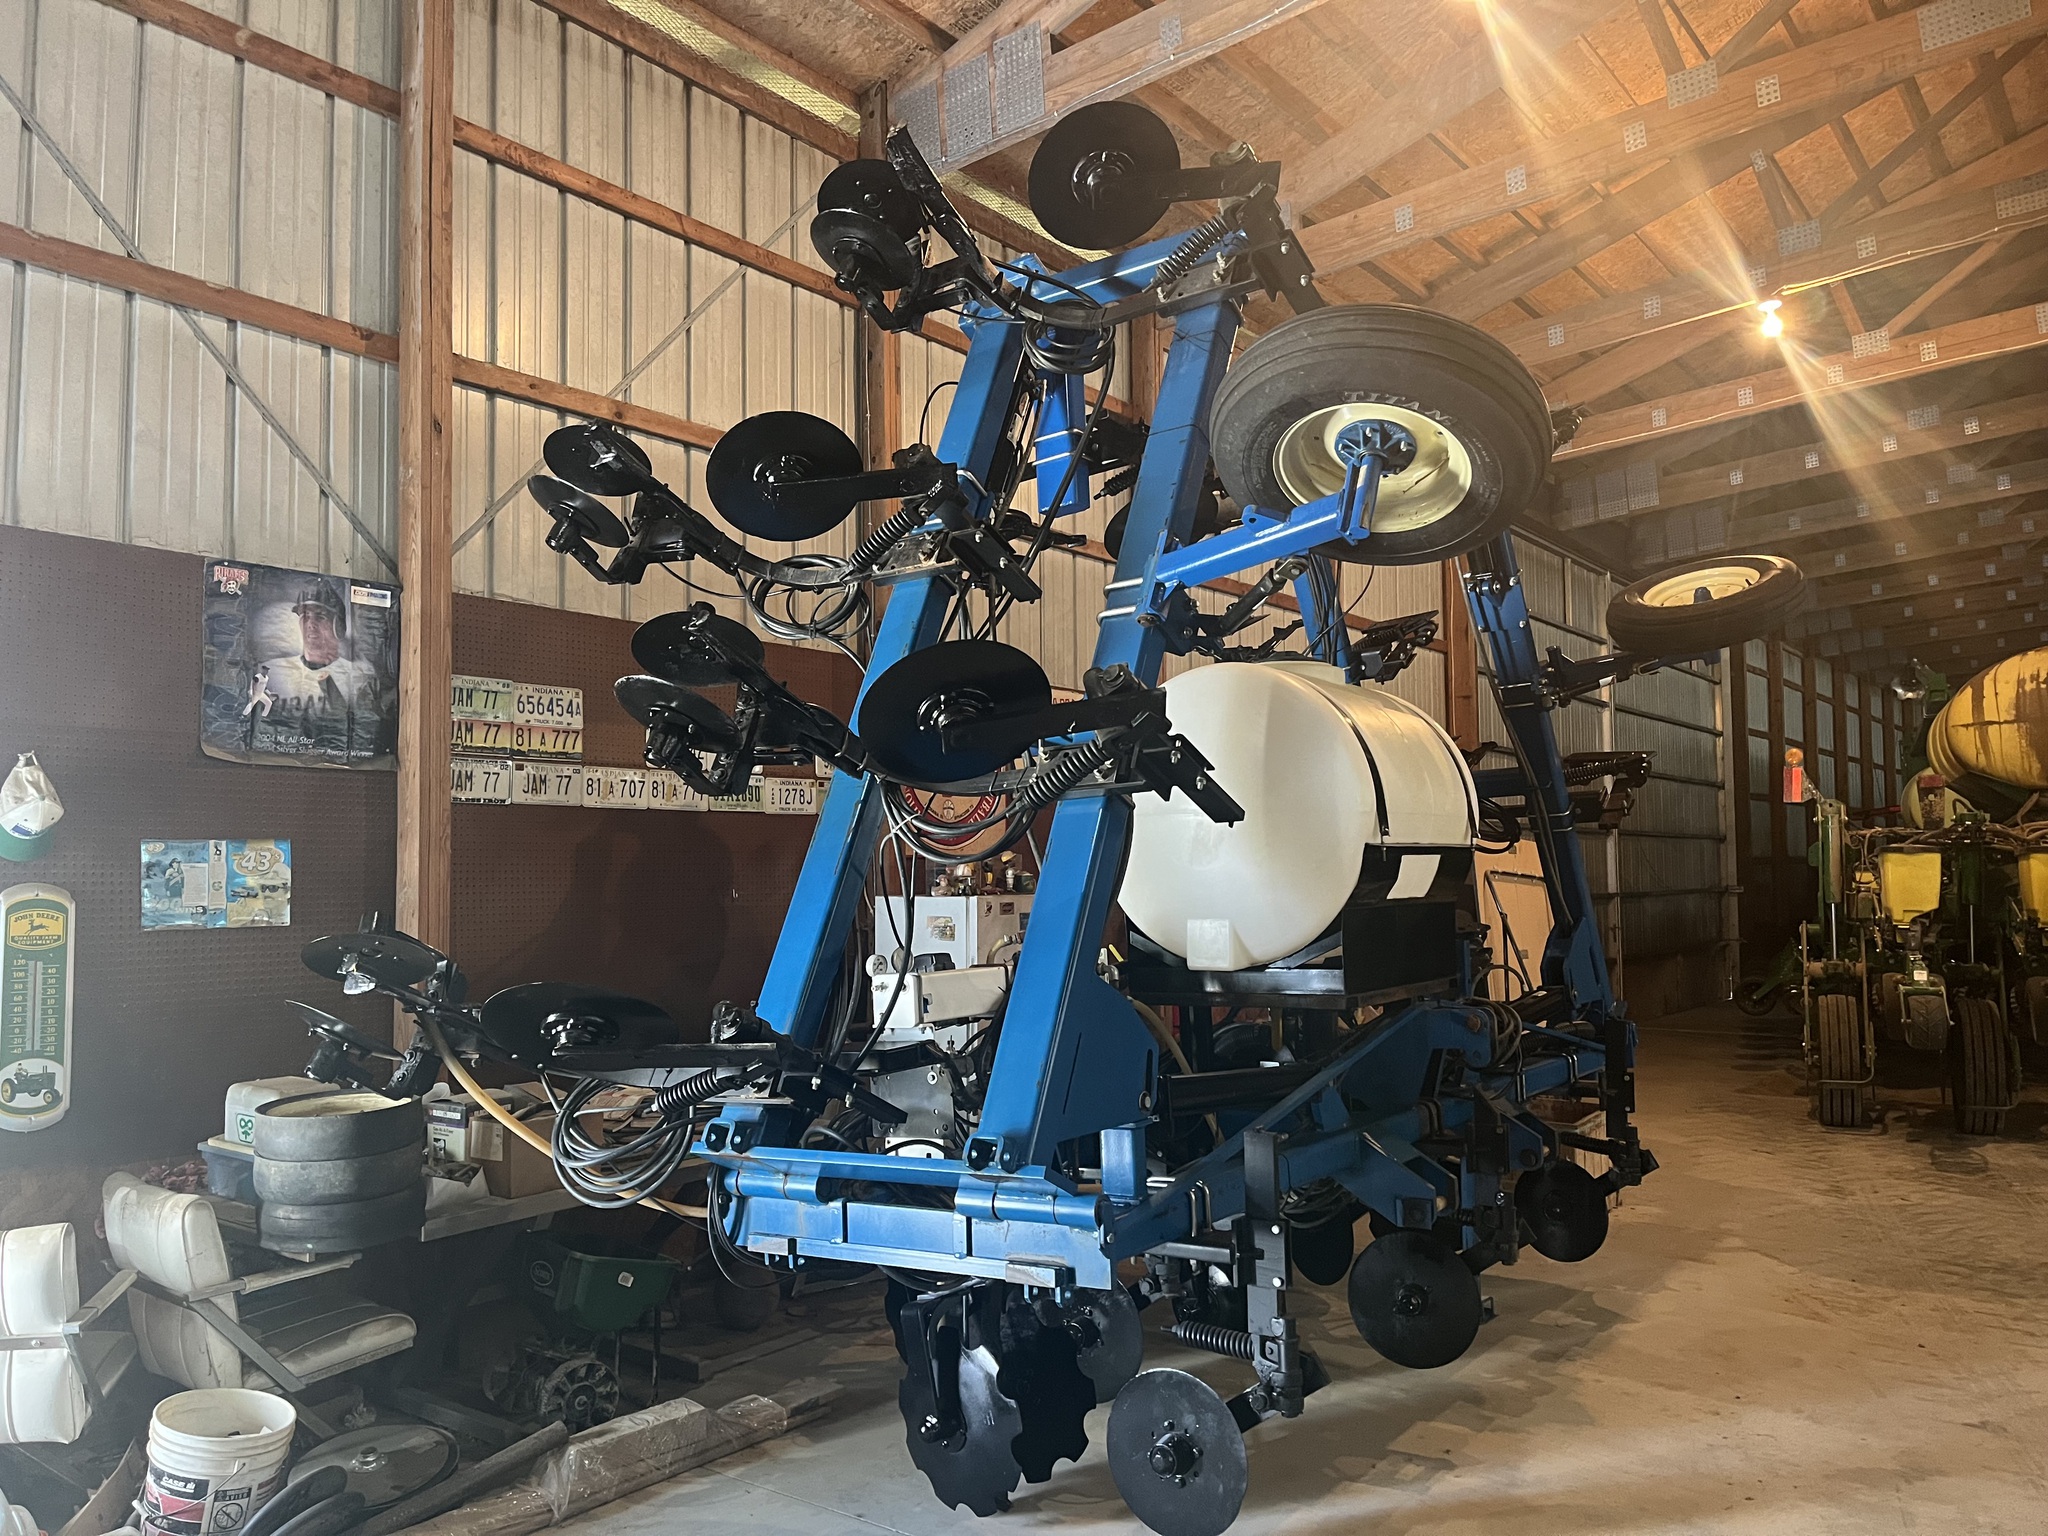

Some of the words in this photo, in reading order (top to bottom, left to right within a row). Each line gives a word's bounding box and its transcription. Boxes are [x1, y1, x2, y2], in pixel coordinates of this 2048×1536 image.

[1343, 390, 1458, 426] TITAN
[213, 565, 249, 582] PIRATES
[461, 679, 490, 687] INDIANA
[532, 687, 564, 696] INDIANA
[451, 687, 473, 707] JAM
[483, 690, 498, 709] 77
[517, 694, 582, 718] 656454A
[451, 720, 473, 743] JAM
[483, 723, 501, 744] 77
[515, 727, 531, 747] 81
[540, 731, 546, 746] A
[552, 730, 580, 750] 777
[451, 769, 473, 792] JAM
[483, 771, 500, 793] 77
[522, 773, 547, 795] JAM
[556, 775, 572, 795] 77
[586, 777, 601, 797] 81
[609, 781, 615, 797] A
[620, 779, 646, 799] 707
[651, 780, 665, 799] 81
[672, 784, 678, 799] A
[778, 788, 812, 805] 1278J
[14, 913, 34, 922] JOHN
[36, 913, 60, 922] DEERE
[174, 906, 204, 914] WINS
[162, 1476, 186, 1488] CASE
